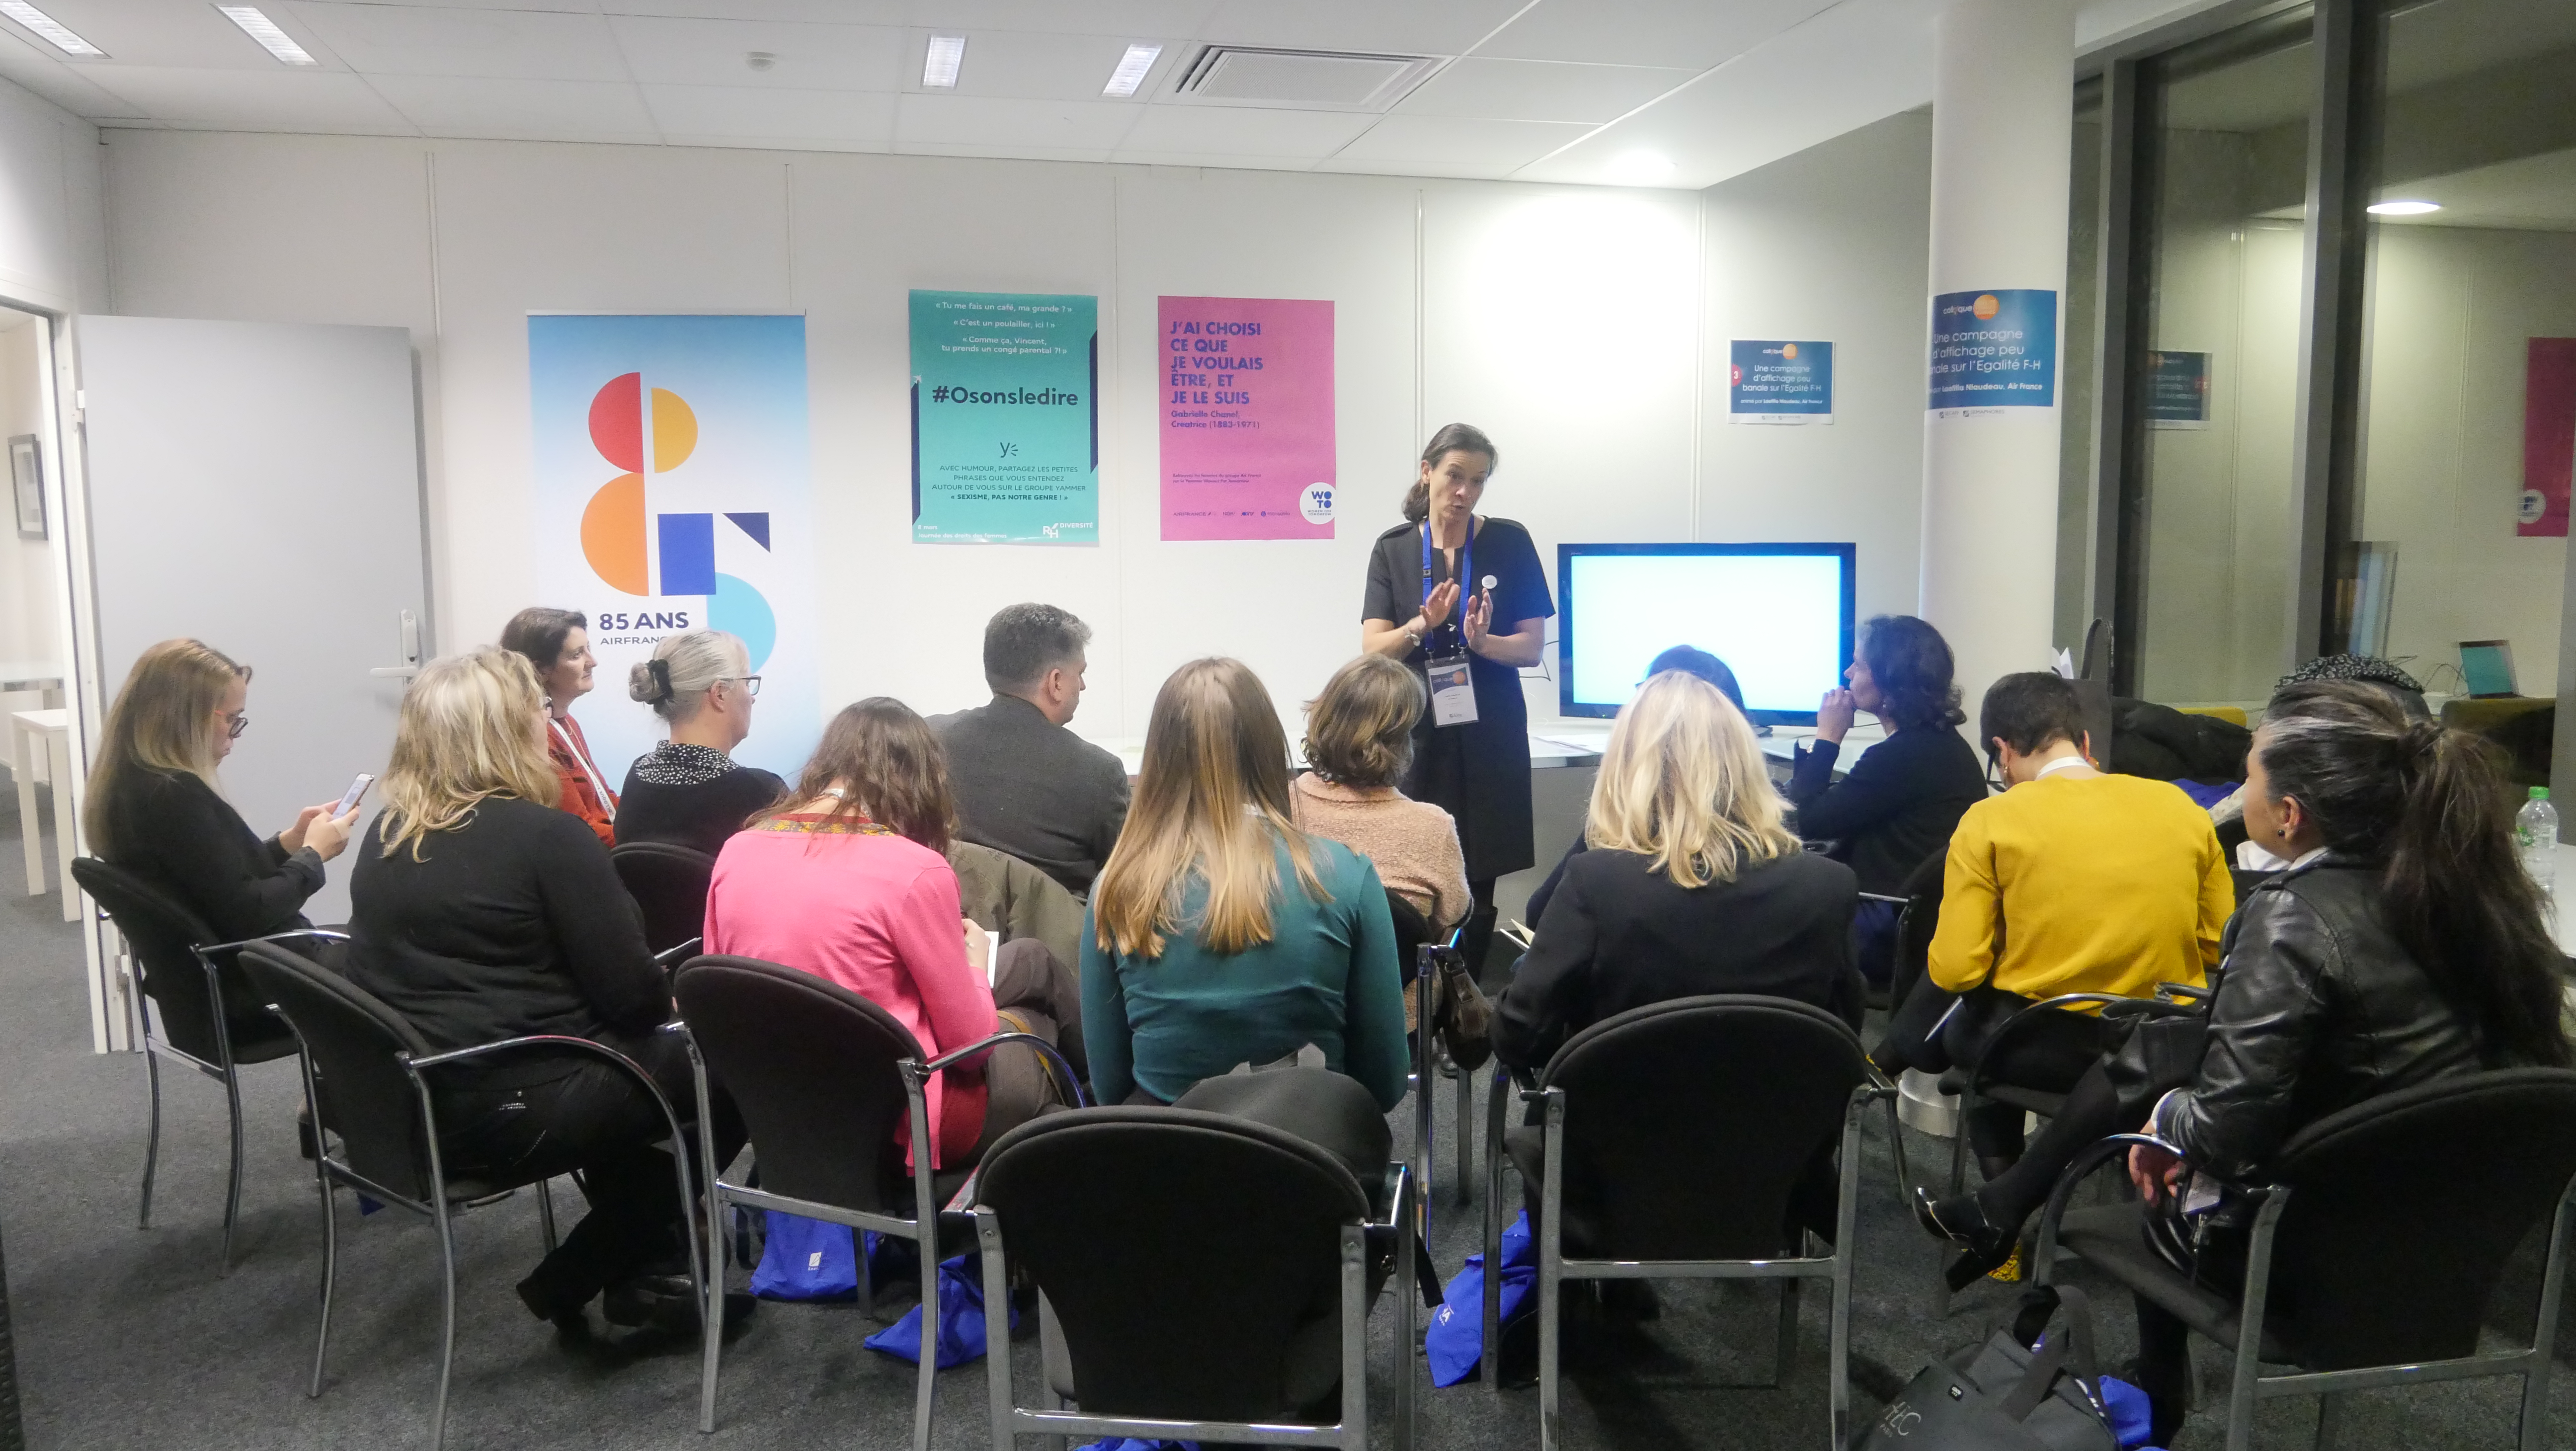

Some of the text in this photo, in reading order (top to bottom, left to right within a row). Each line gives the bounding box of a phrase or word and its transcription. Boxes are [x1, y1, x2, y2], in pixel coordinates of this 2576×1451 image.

[1032, 305, 1059, 314] grande
[995, 320, 1033, 329] poulailler,
[1170, 321, 1261, 335] J'AI CHOISI
[1933, 330, 2023, 344] Une campagne
[953, 344, 979, 353] prends
[994, 346, 1017, 355] congé
[1170, 338, 1227, 352] CE QUE
[1933, 345, 2024, 359] d'affichage peu
[1170, 356, 1264, 370] JE VOULAIS
[1951, 363, 1966, 372] sur
[1969, 359, 2019, 373] l'Egalité
[2023, 360, 2041, 370] F-H
[1171, 369, 1234, 389] ÊTRE, ET
[1733, 371, 1739, 379] 3
[1753, 374, 1795, 383] d'affichage
[1781, 384, 1808, 393] l'Egalité
[932, 386, 1079, 406] #Osonsledire
[1171, 391, 1250, 404] JE LE SUIS
[599, 612, 689, 630] 85 ANS
